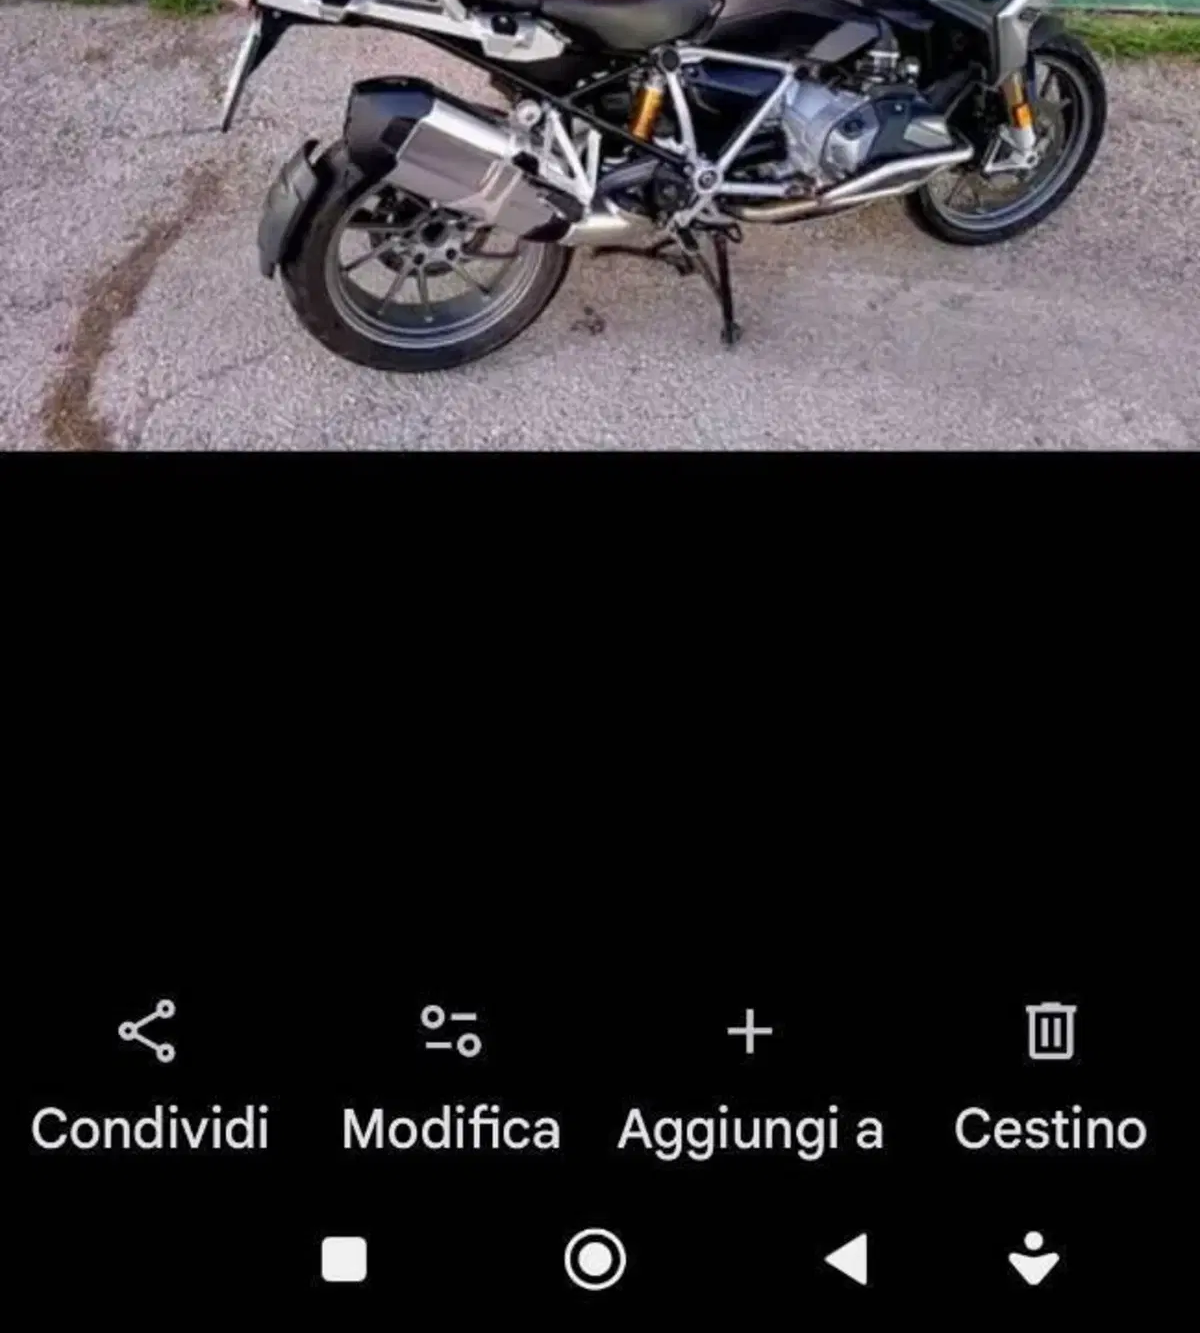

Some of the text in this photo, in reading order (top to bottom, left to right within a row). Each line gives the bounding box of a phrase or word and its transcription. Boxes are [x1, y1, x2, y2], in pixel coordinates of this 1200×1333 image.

[31, 1103, 270, 1150] Condividi
[342, 1103, 561, 1150] Modifica
[616, 1103, 884, 1162] Aggiungi a
[954, 1103, 1148, 1150] Cestino
